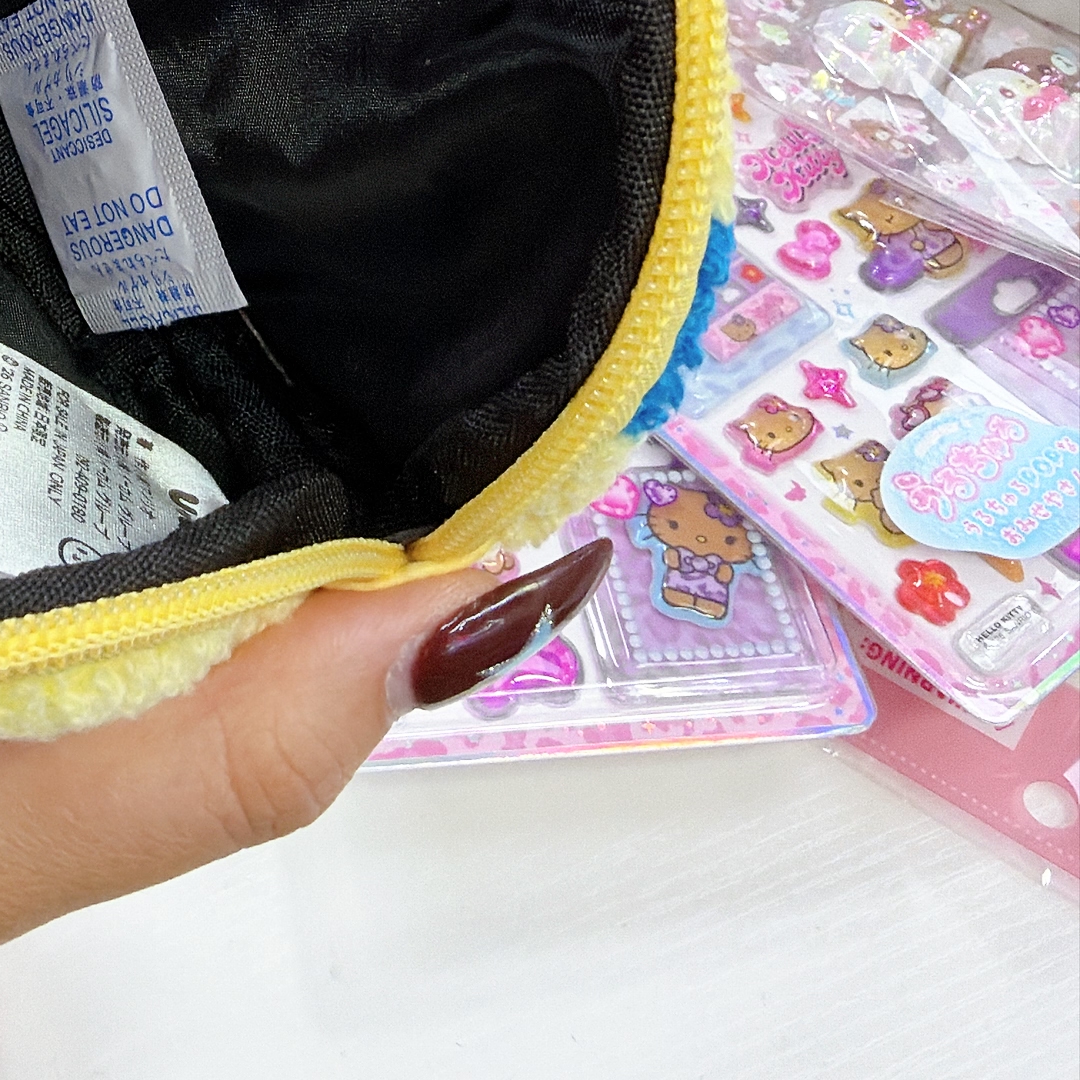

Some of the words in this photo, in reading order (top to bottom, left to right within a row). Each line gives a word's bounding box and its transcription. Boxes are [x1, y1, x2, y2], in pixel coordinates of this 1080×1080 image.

[2, 1, 94, 62] DANGEROUS
[32, 96, 114, 146] SILICAGEL
[51, 127, 113, 163] DESICCANT
[93, 197, 129, 227] NOT
[129, 186, 163, 214] DO
[61, 209, 92, 236] EAT
[70, 215, 174, 262] DANGEROUS
[21, 365, 36, 394] MADE
[55, 386, 70, 408] FOR
[13, 403, 31, 432] CHINA
[54, 406, 69, 431] SALE
[51, 439, 67, 471] JAPAN
[892, 413, 1029, 524] うるちゅる
[46, 472, 65, 508] ONLY
[1000, 468, 1080, 547] おみせやさ
[975, 621, 1002, 644] HELLO
[1000, 604, 1024, 624] KITTY
